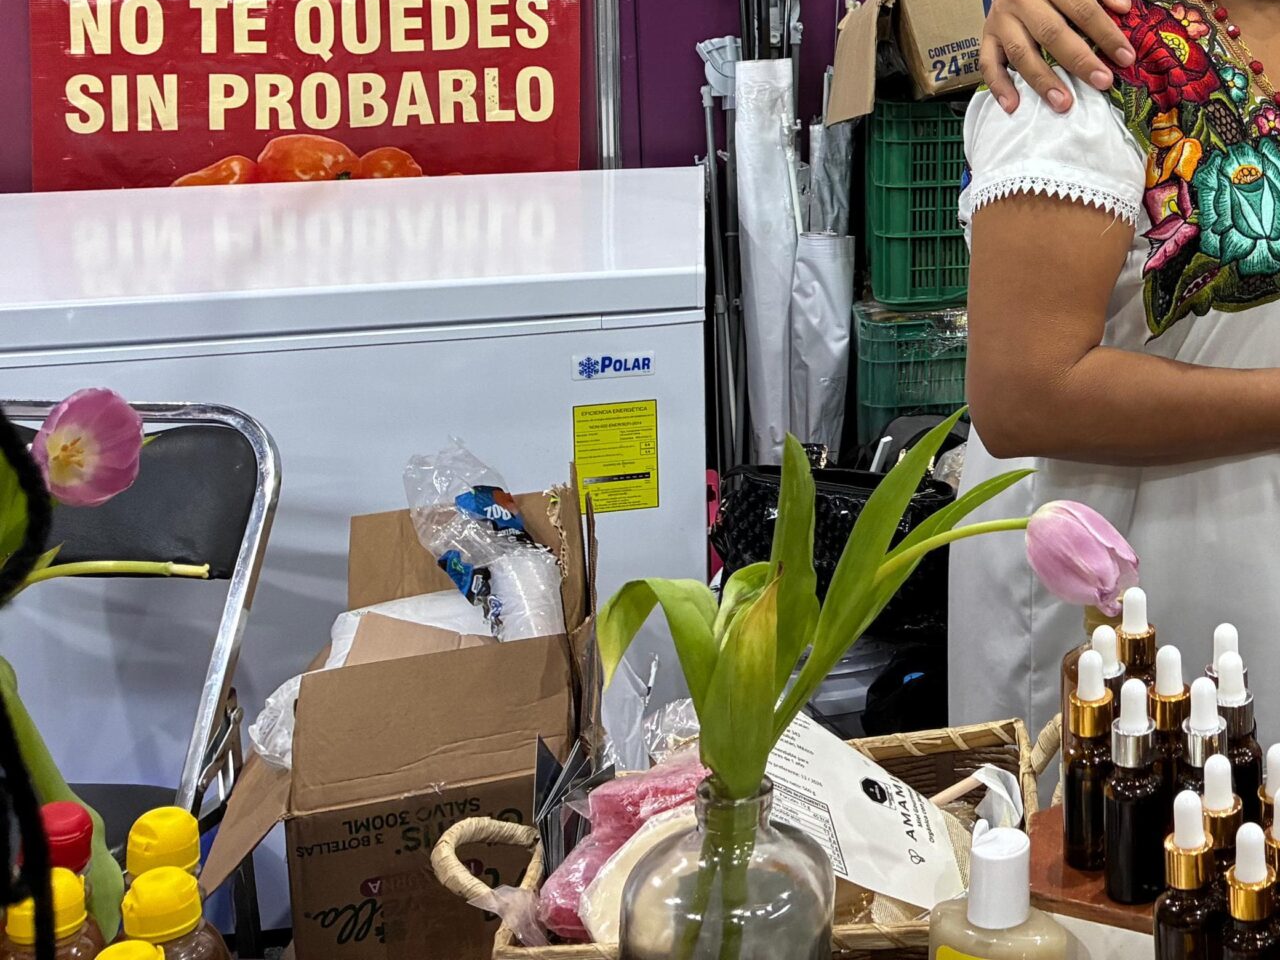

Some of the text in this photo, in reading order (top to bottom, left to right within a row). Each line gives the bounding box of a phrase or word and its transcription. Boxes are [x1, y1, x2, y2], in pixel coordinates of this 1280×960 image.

[928, 37, 980, 59] CONTENIDO:
[961, 49, 980, 61] PIEZ
[932, 55, 961, 82] 24
[64, 65, 555, 136] SIN PROBARLO
[600, 356, 651, 373] POLAR
[343, 810, 410, 835] 300ML
[296, 835, 371, 858] BOTELLAS
